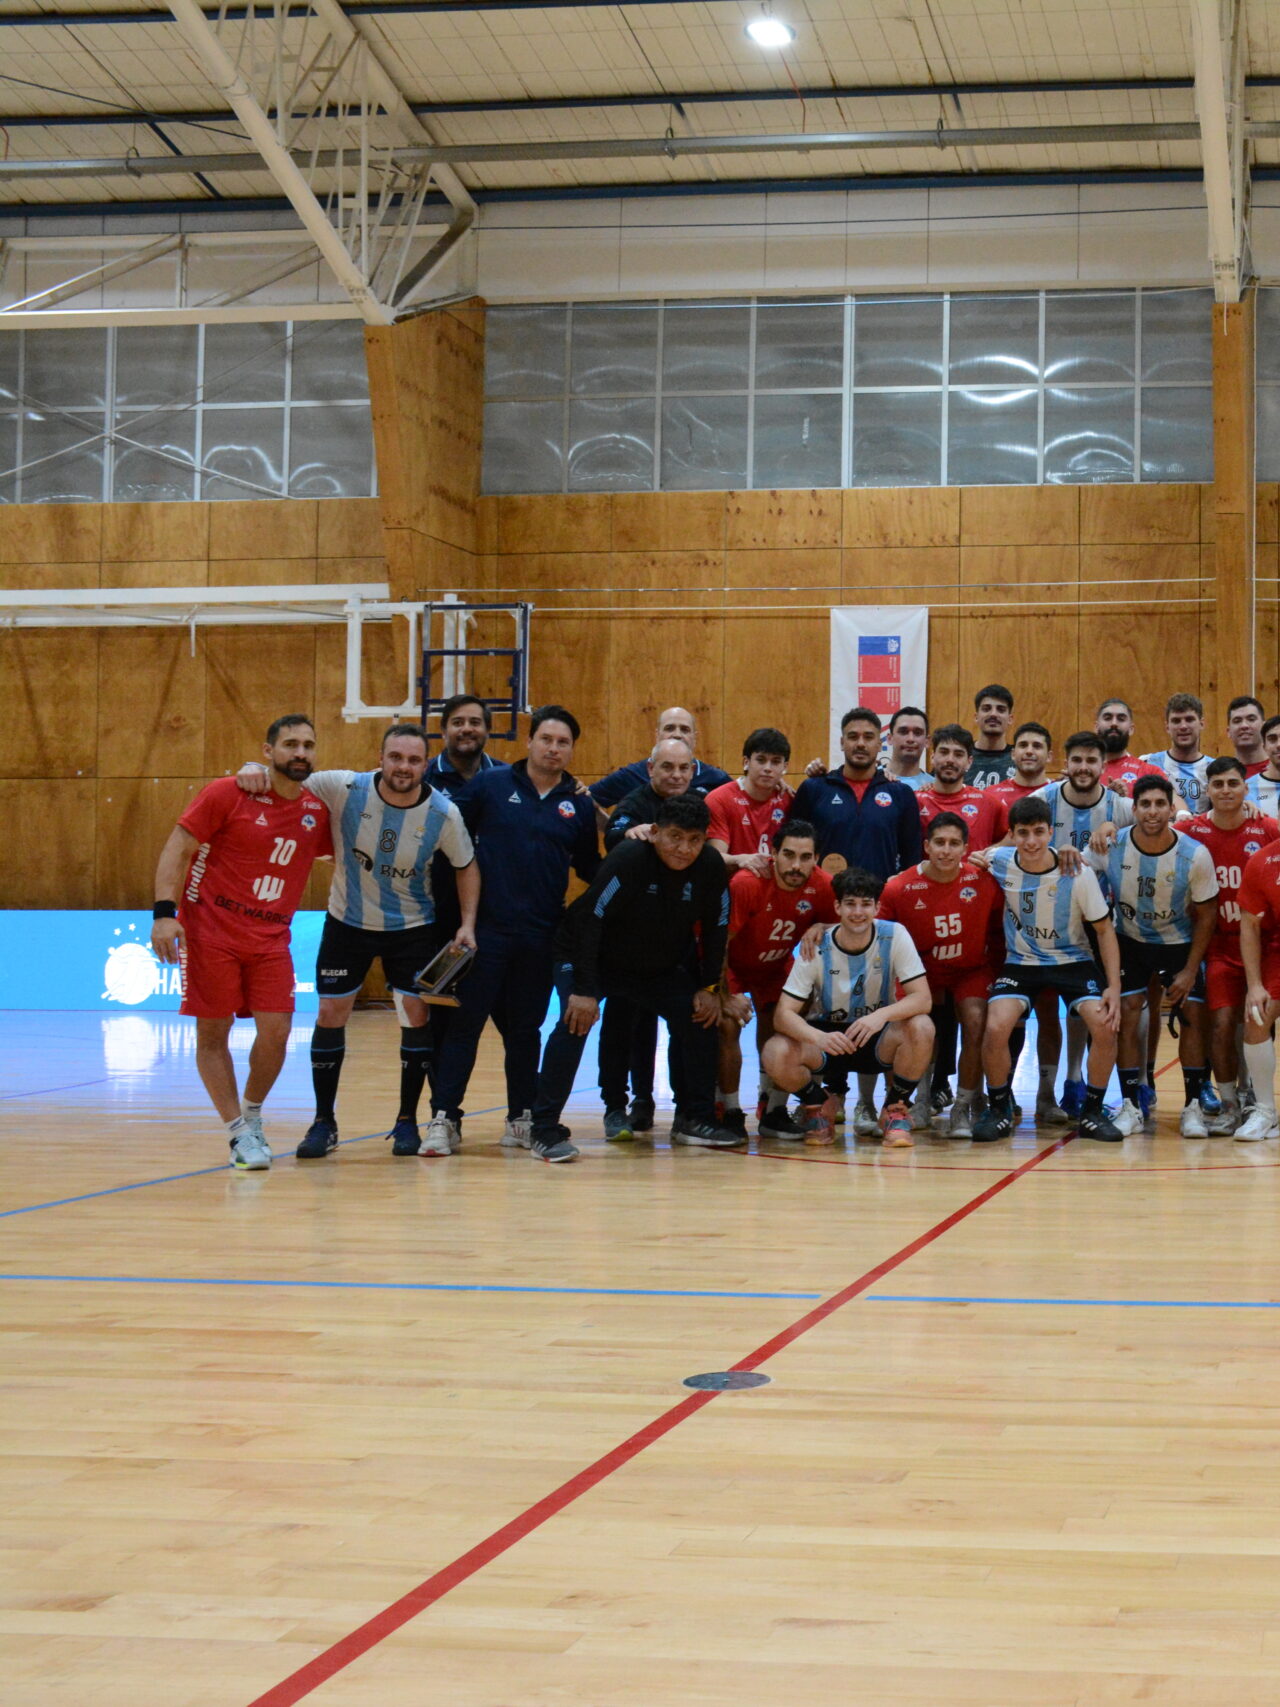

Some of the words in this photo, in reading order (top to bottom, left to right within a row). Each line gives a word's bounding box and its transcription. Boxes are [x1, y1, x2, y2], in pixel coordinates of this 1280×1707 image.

[1175, 778, 1200, 799] 30
[269, 837, 297, 866] 10
[380, 829, 397, 853] 8
[1070, 831, 1091, 851] 18
[380, 864, 417, 879] BNA
[1216, 866, 1241, 889] 30
[1137, 876, 1156, 897] 15
[1023, 892, 1034, 913] 5
[769, 919, 796, 940] 22
[934, 913, 962, 938] 55
[1026, 926, 1061, 939] BNA
[853, 974, 865, 996] 6
